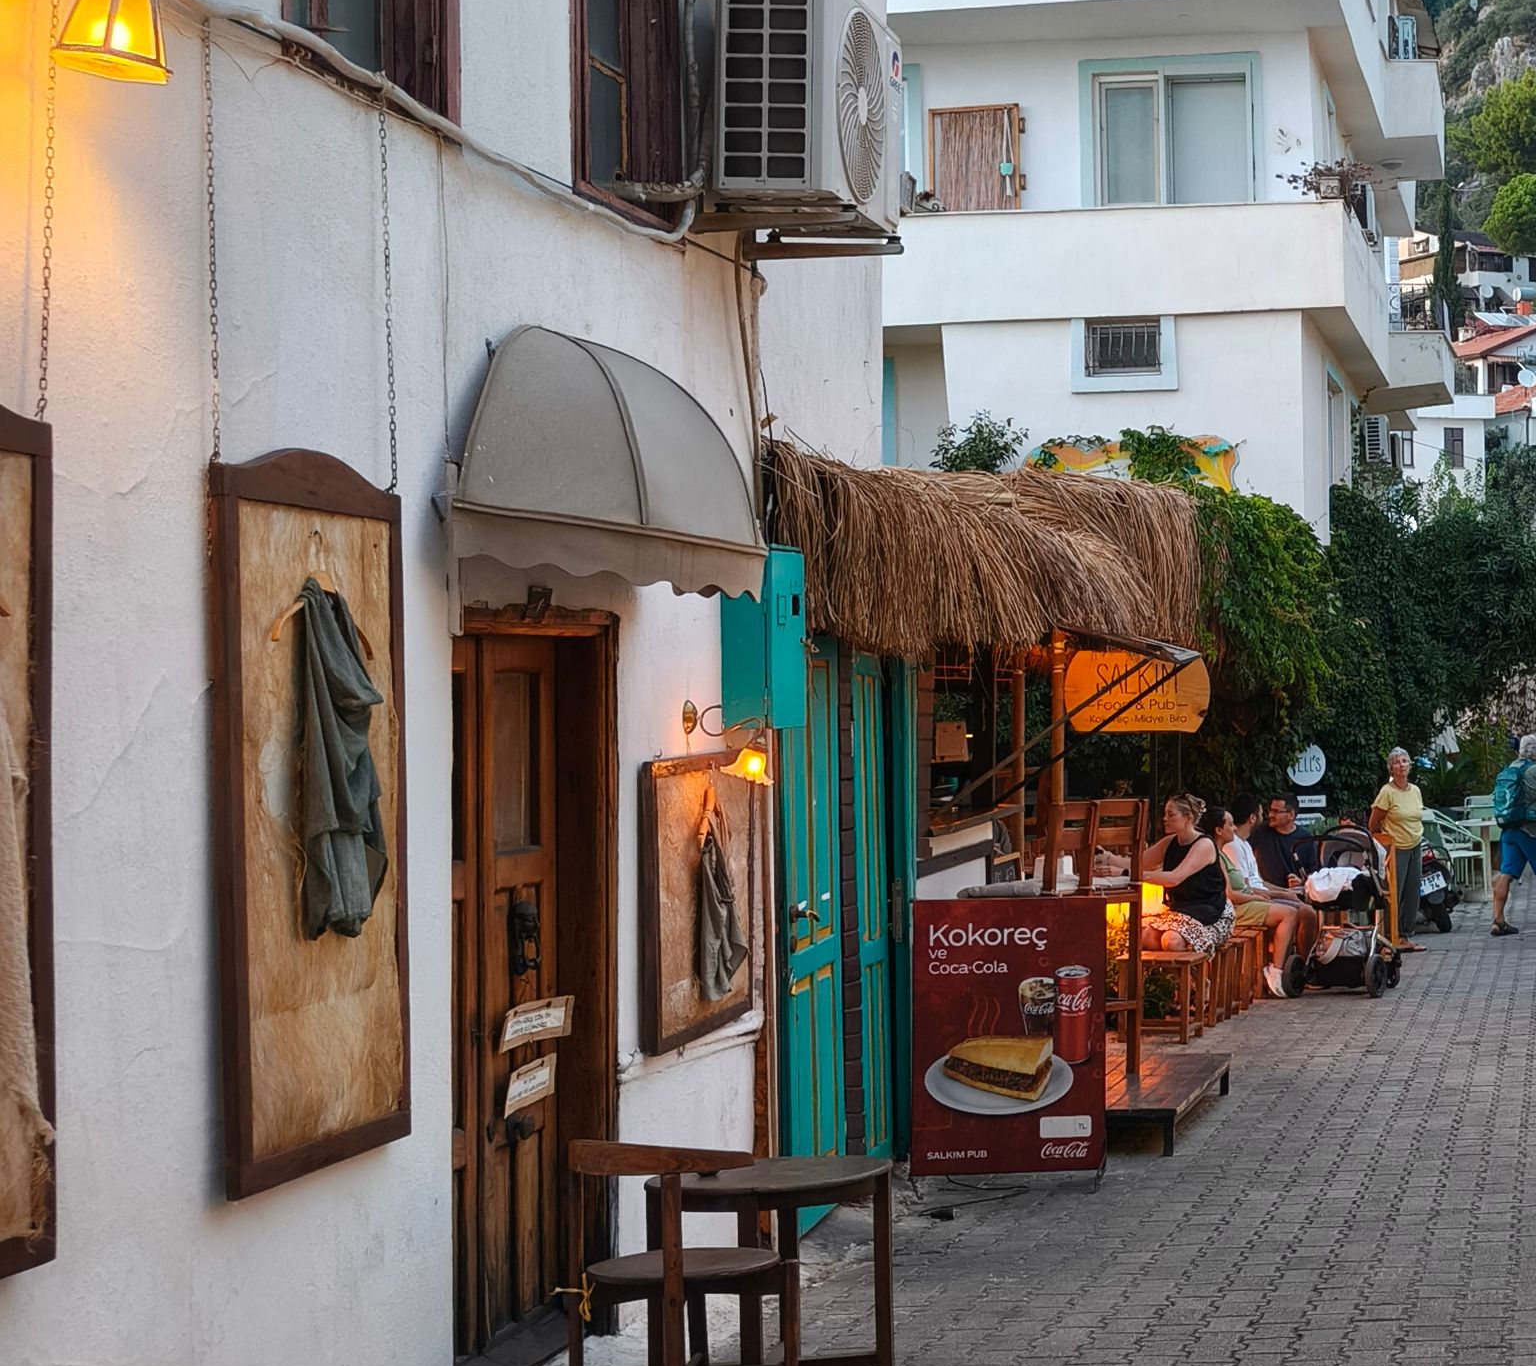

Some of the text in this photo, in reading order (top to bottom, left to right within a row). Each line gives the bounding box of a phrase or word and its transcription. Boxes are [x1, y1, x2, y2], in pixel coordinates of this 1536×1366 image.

[1150, 698, 1175, 711] Pub
[1135, 714, 1163, 723] Midye
[929, 923, 1048, 950] Kokoreç
[928, 948, 947, 959] ve
[1078, 1122, 1087, 1130] TL
[927, 1150, 988, 1160] SALKIM PUB
[1041, 1141, 1090, 1159] Coca-Cola
